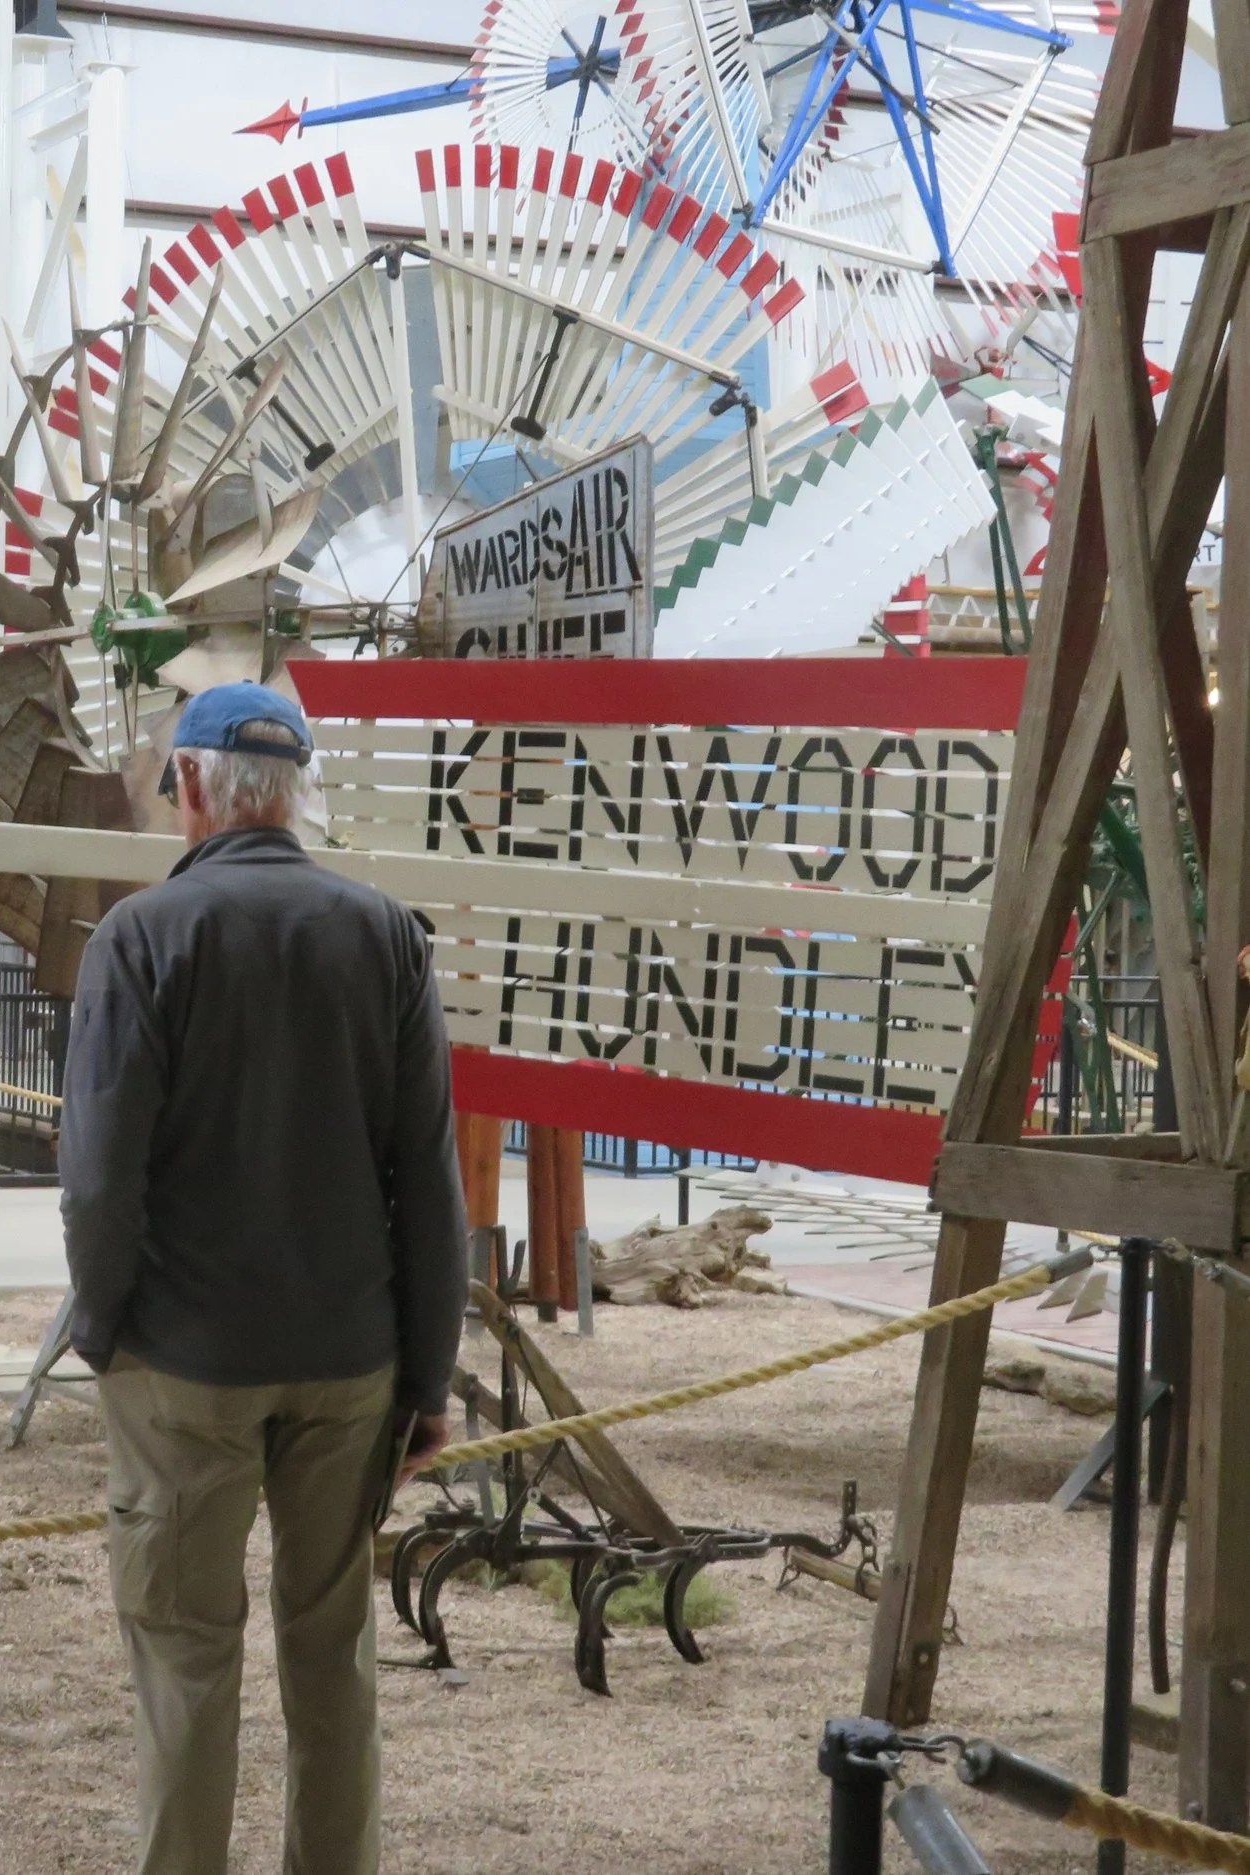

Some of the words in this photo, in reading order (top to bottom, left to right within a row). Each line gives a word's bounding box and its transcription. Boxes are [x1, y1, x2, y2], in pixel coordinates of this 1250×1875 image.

[451, 506, 568, 597] WARDS
[565, 467, 643, 593] AIR
[426, 730, 999, 893] KENWOOD
